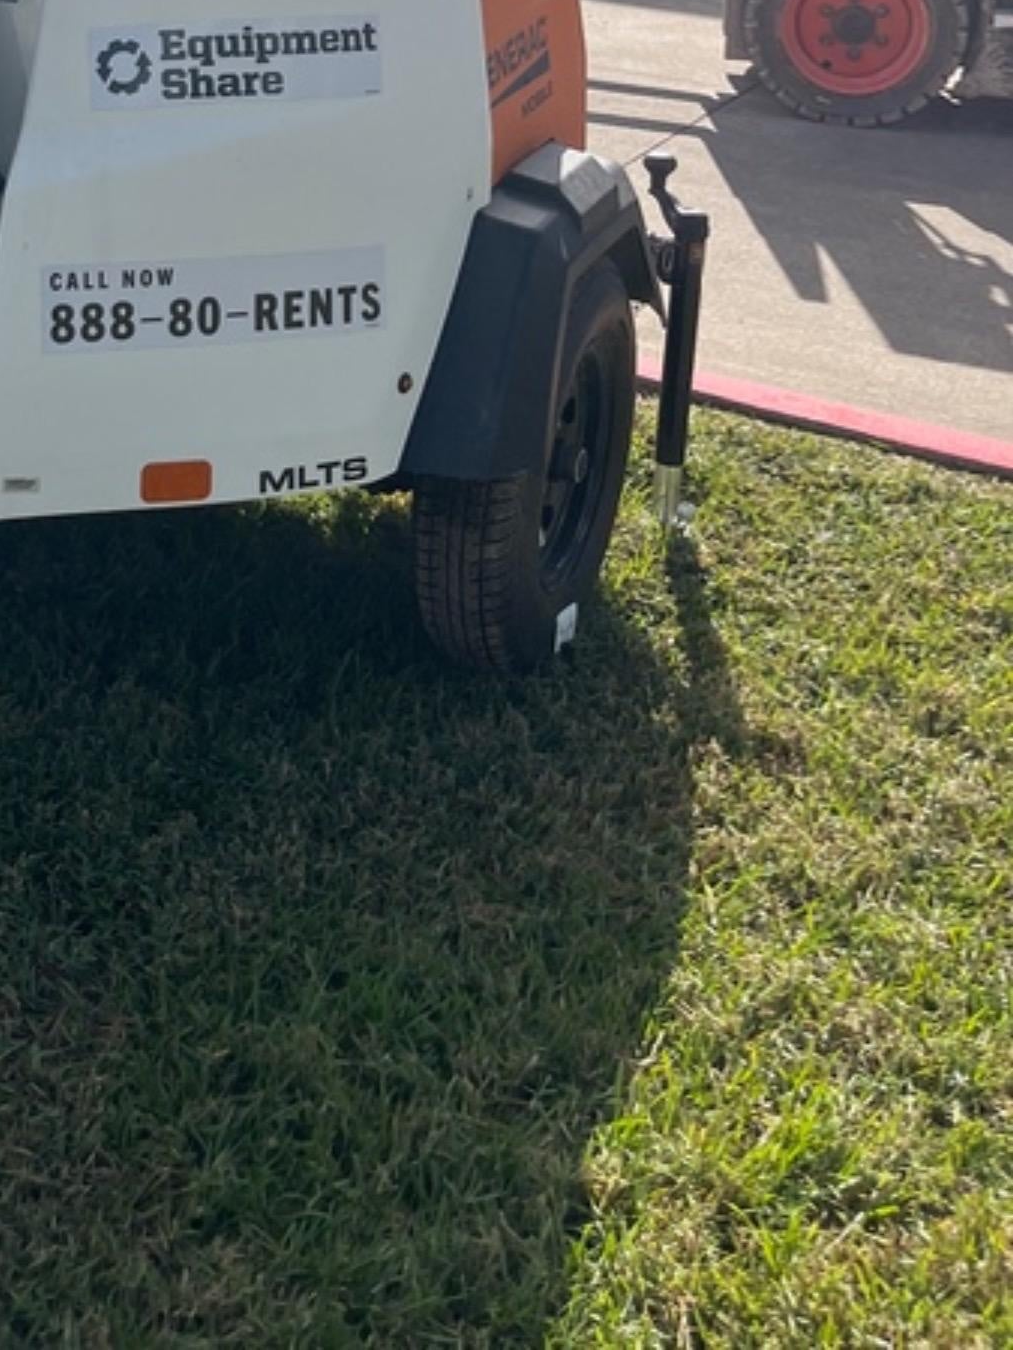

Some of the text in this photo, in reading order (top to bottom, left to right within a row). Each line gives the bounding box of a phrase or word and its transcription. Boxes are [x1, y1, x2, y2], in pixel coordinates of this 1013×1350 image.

[158, 23, 378, 66] Equipment
[487, 16, 548, 90] ENERAC
[161, 67, 284, 99] Share
[49, 267, 175, 291] CALL NOW
[50, 282, 382, 344] 888-80-RENTS
[259, 456, 368, 494] MLTS
